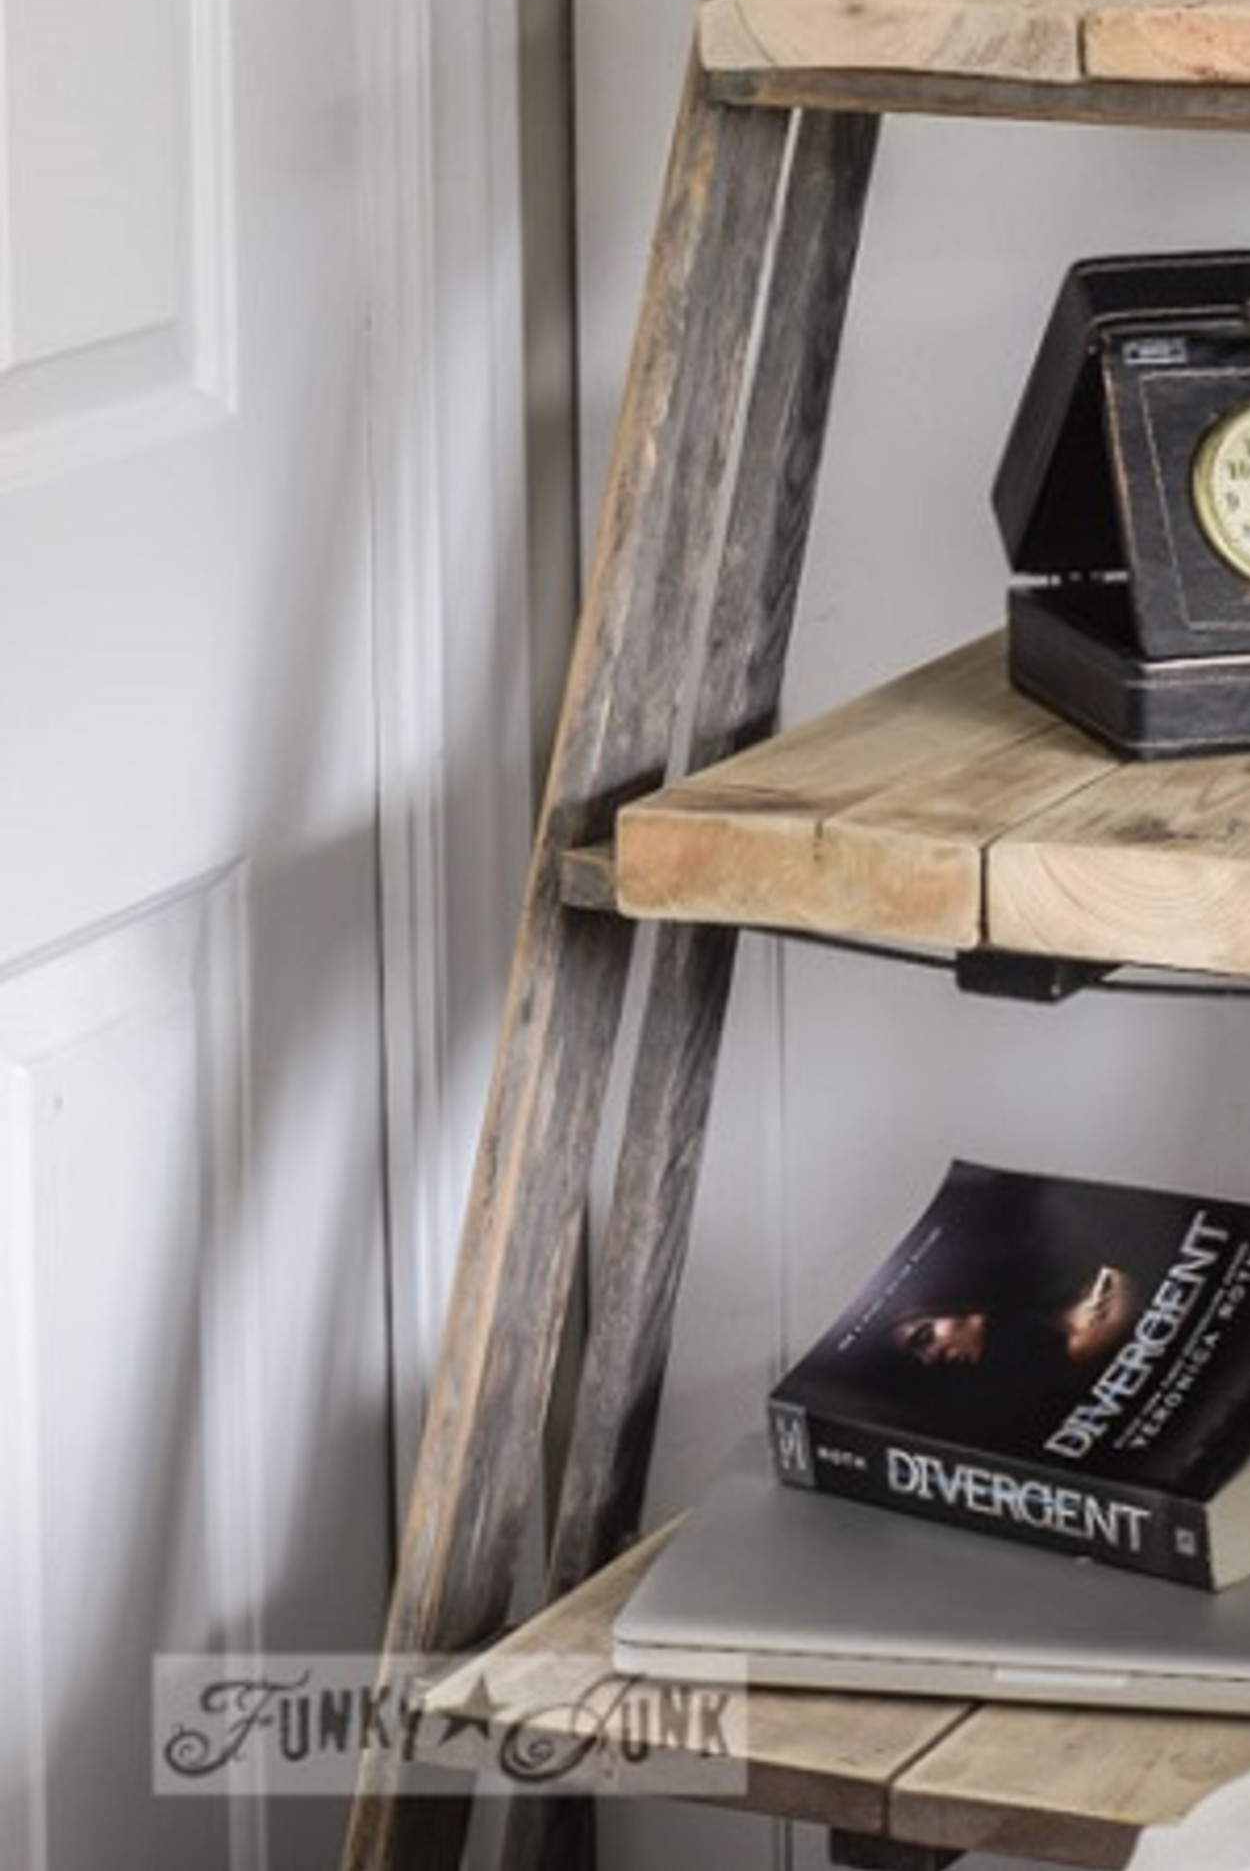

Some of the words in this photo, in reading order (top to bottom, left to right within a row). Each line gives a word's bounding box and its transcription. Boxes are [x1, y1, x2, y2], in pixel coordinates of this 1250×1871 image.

[1043, 1210, 1229, 1458] DIVERGENT
[1130, 1331, 1221, 1447] VERONICA
[886, 1446, 1152, 1554] DIVERGENT
